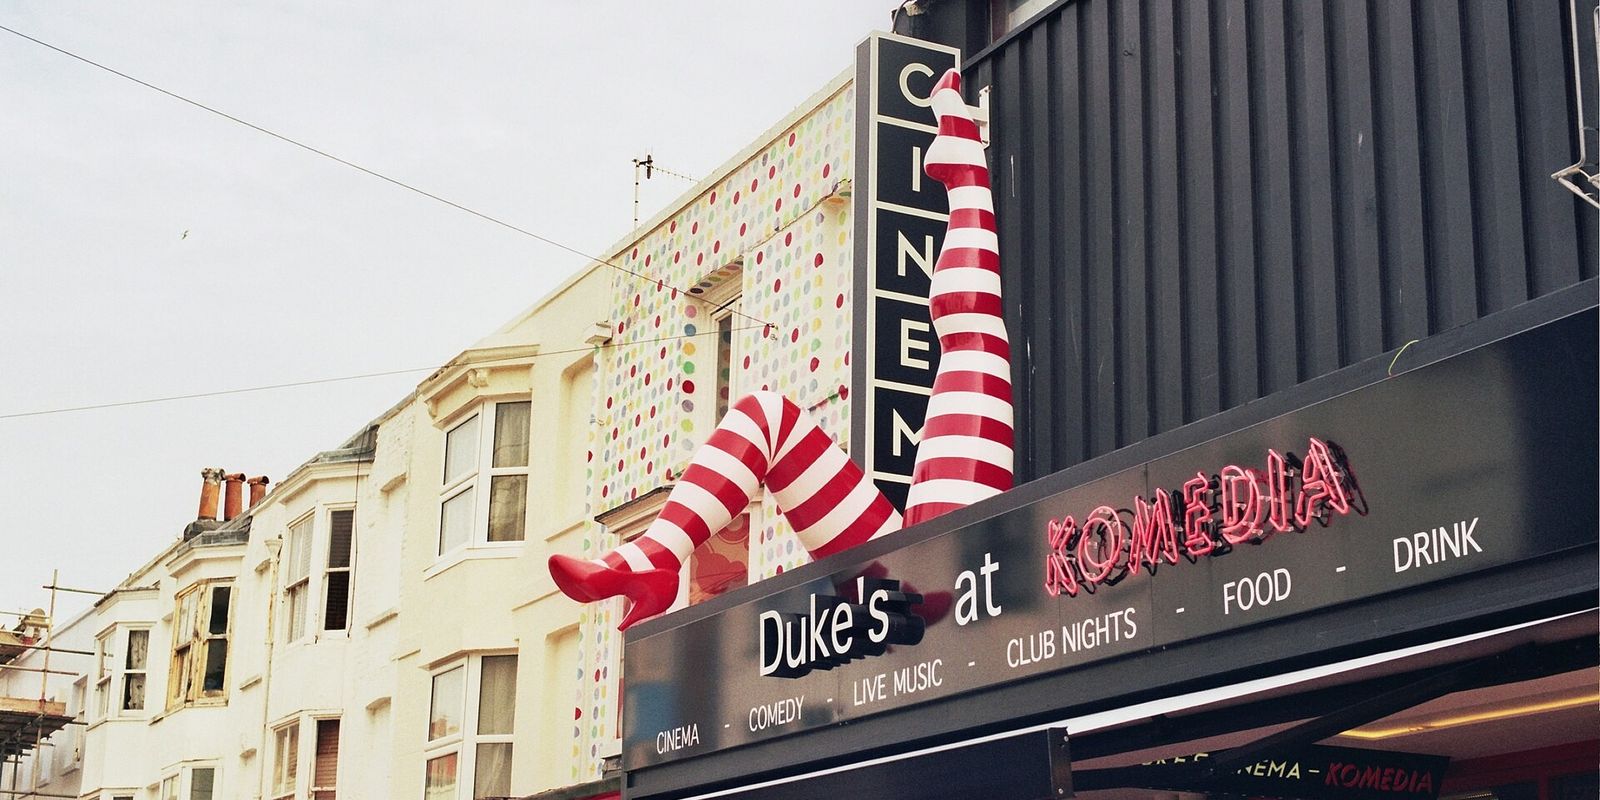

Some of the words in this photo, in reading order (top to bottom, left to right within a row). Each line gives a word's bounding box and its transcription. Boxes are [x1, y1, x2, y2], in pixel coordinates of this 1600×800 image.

[893, 62, 935, 457] CINEM
[656, 723, 700, 755] CINEMA
[748, 695, 805, 732] COMEDY
[853, 673, 887, 706] LIVE
[893, 658, 943, 696] MUSIC
[1006, 629, 1056, 668] CLUB
[1062, 607, 1137, 655] NIGHTS
[1222, 567, 1292, 615] FOOD
[1393, 517, 1483, 573] DRINK
[760, 576, 890, 678] Duke's
[954, 552, 1002, 626] at
[1044, 437, 1350, 597] KOMEDIA
[1323, 761, 1434, 794] KOMEDIA
